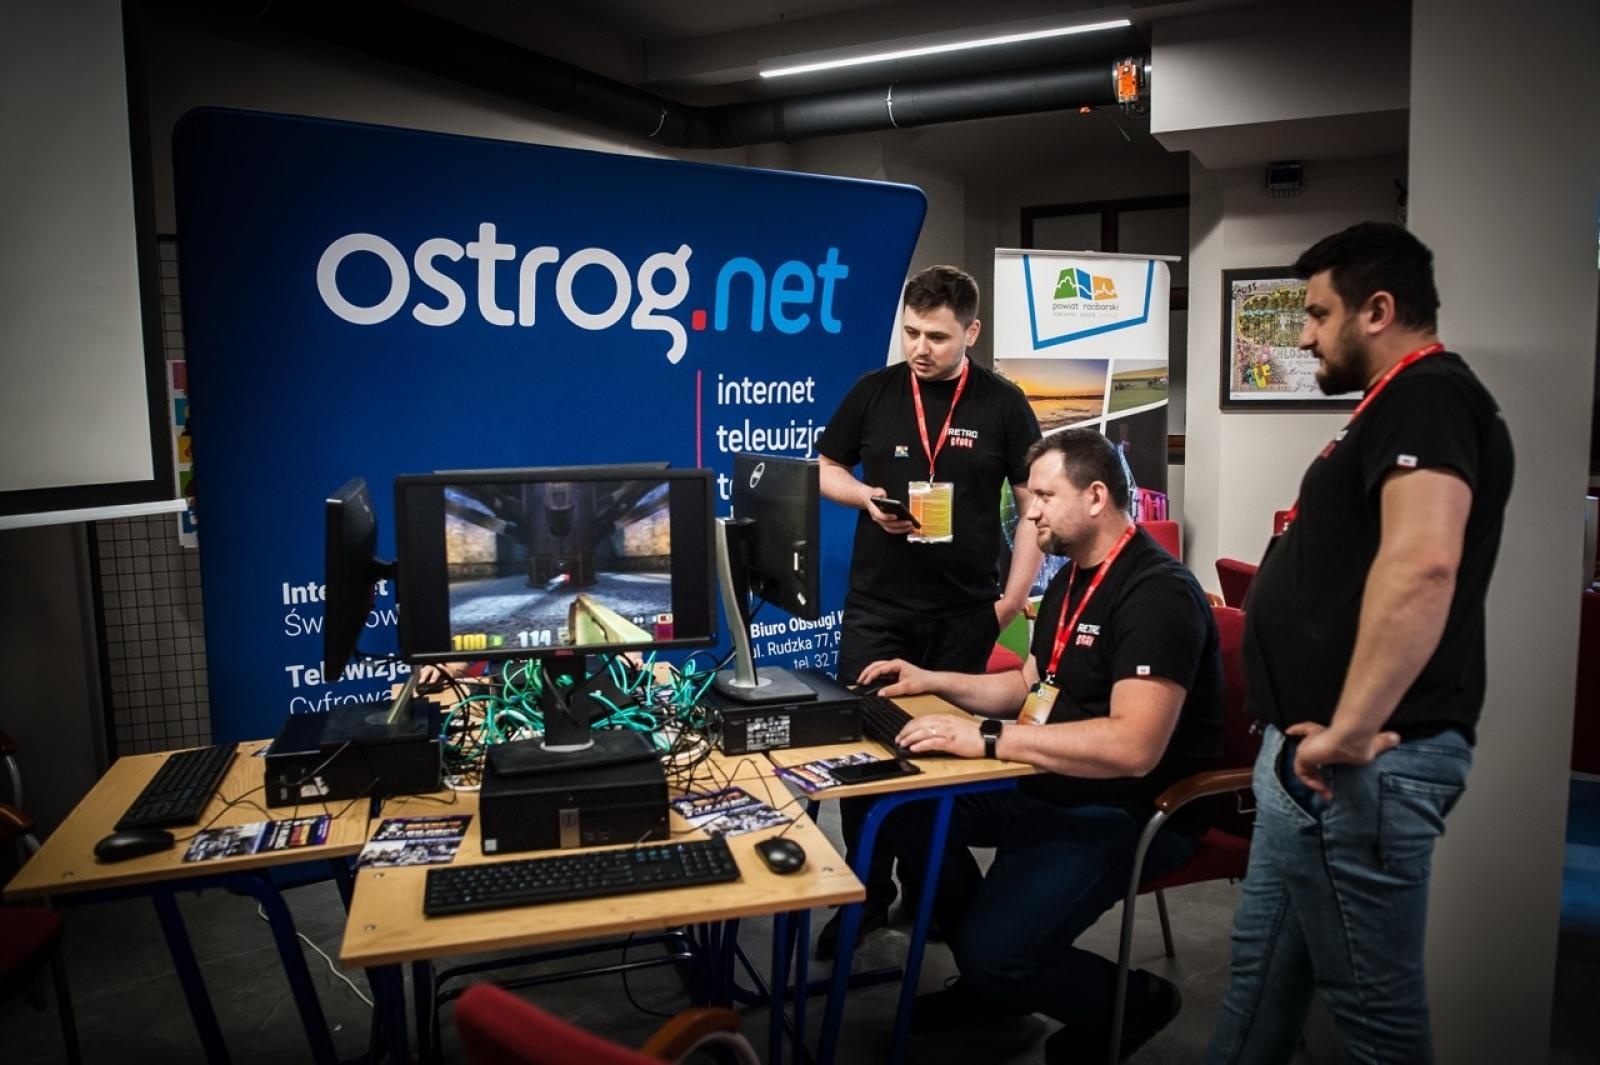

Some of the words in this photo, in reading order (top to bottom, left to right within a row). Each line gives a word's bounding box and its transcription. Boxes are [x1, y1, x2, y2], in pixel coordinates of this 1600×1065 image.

[316, 222, 849, 364] ostrog.net
[1052, 303, 1079, 311] powiat
[717, 373, 816, 405] internet
[948, 428, 979, 440] RETRO
[750, 622, 786, 638] Biuro
[452, 633, 487, 651] 100
[517, 630, 551, 647] 114
[767, 636, 813, 656] Rudzka
[814, 652, 830, 668] 32
[285, 653, 411, 688] Telwizja
